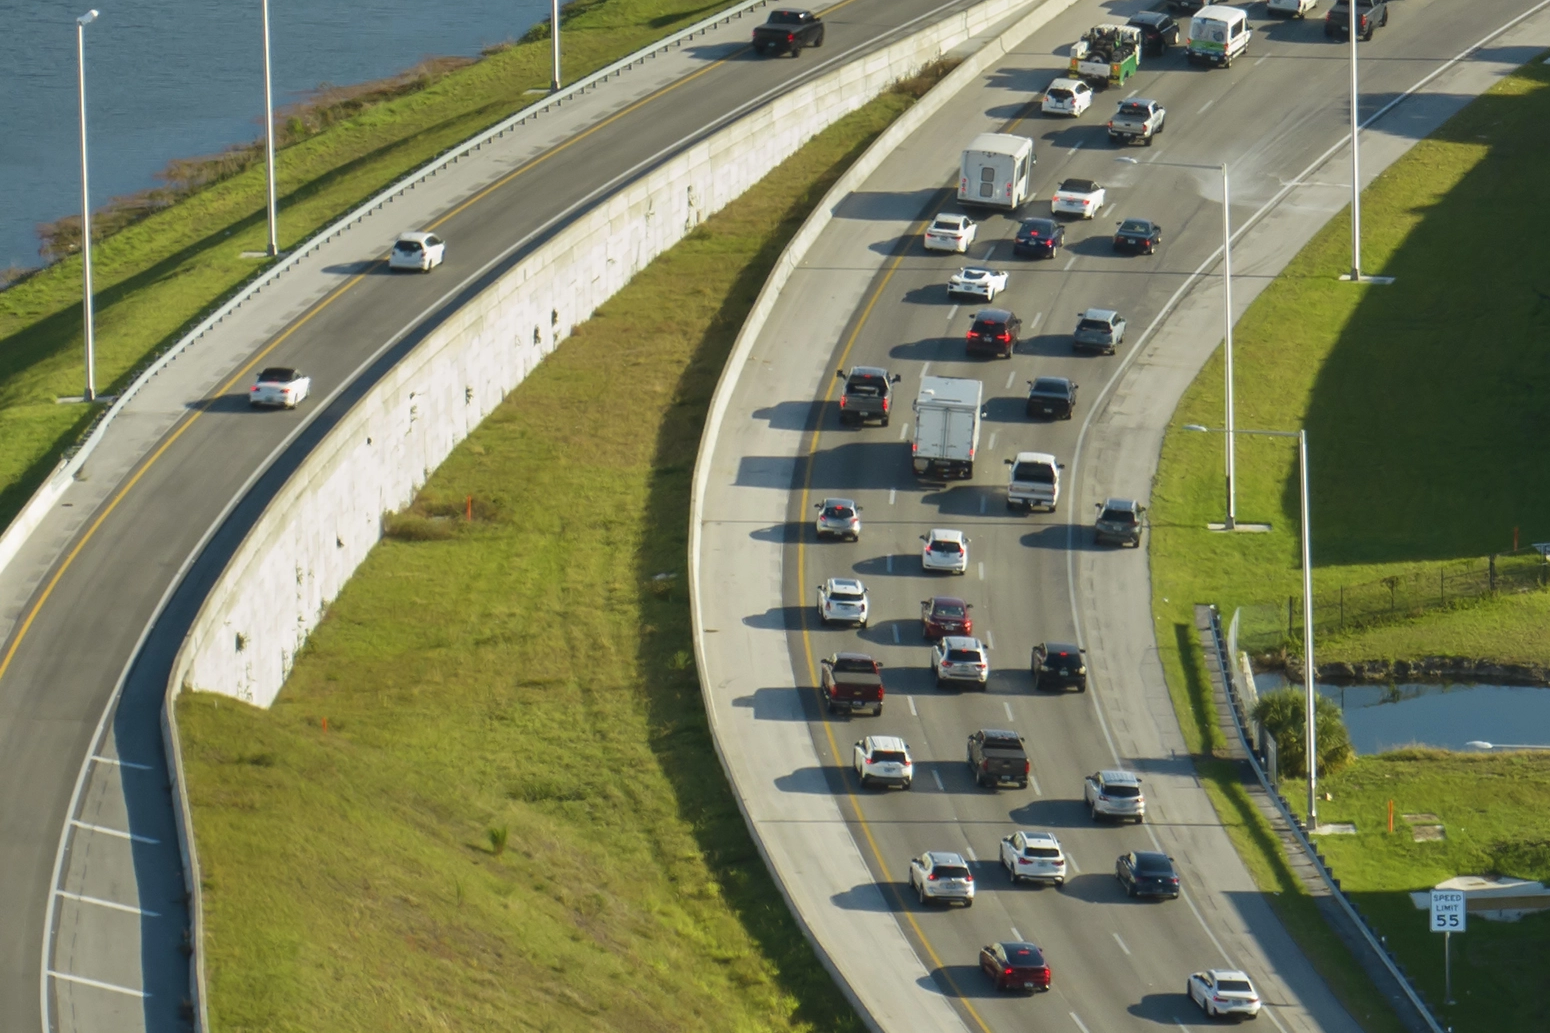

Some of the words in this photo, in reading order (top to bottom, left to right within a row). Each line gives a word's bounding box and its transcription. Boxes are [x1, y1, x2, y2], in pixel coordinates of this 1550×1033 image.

[1433, 894, 1461, 902] SPEED
[1436, 904, 1459, 912] LIMIT
[1436, 914, 1459, 927] 55
